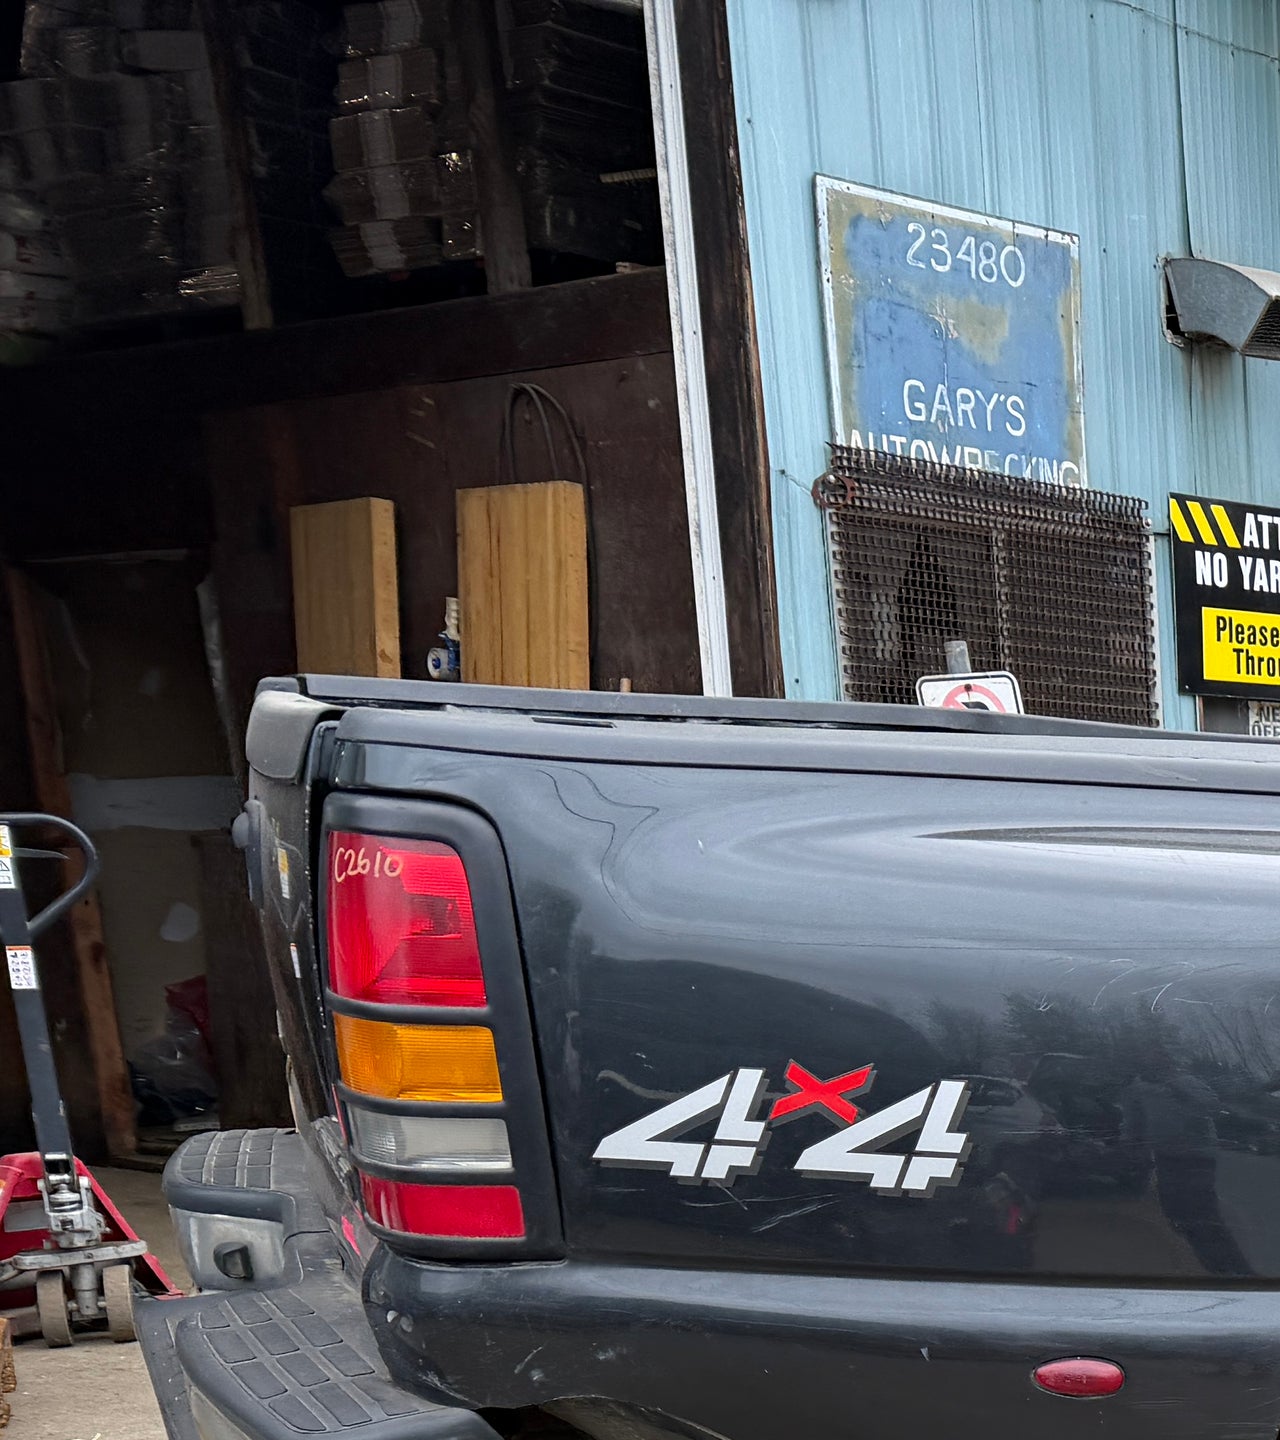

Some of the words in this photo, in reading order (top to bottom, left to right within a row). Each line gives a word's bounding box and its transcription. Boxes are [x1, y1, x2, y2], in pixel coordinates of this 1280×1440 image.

[906, 222, 1026, 288] 23480
[903, 379, 1026, 437] GARY'S
[1194, 550, 1229, 588] NO
[1215, 615, 1280, 648] Please
[335, 847, 403, 883] C2610
